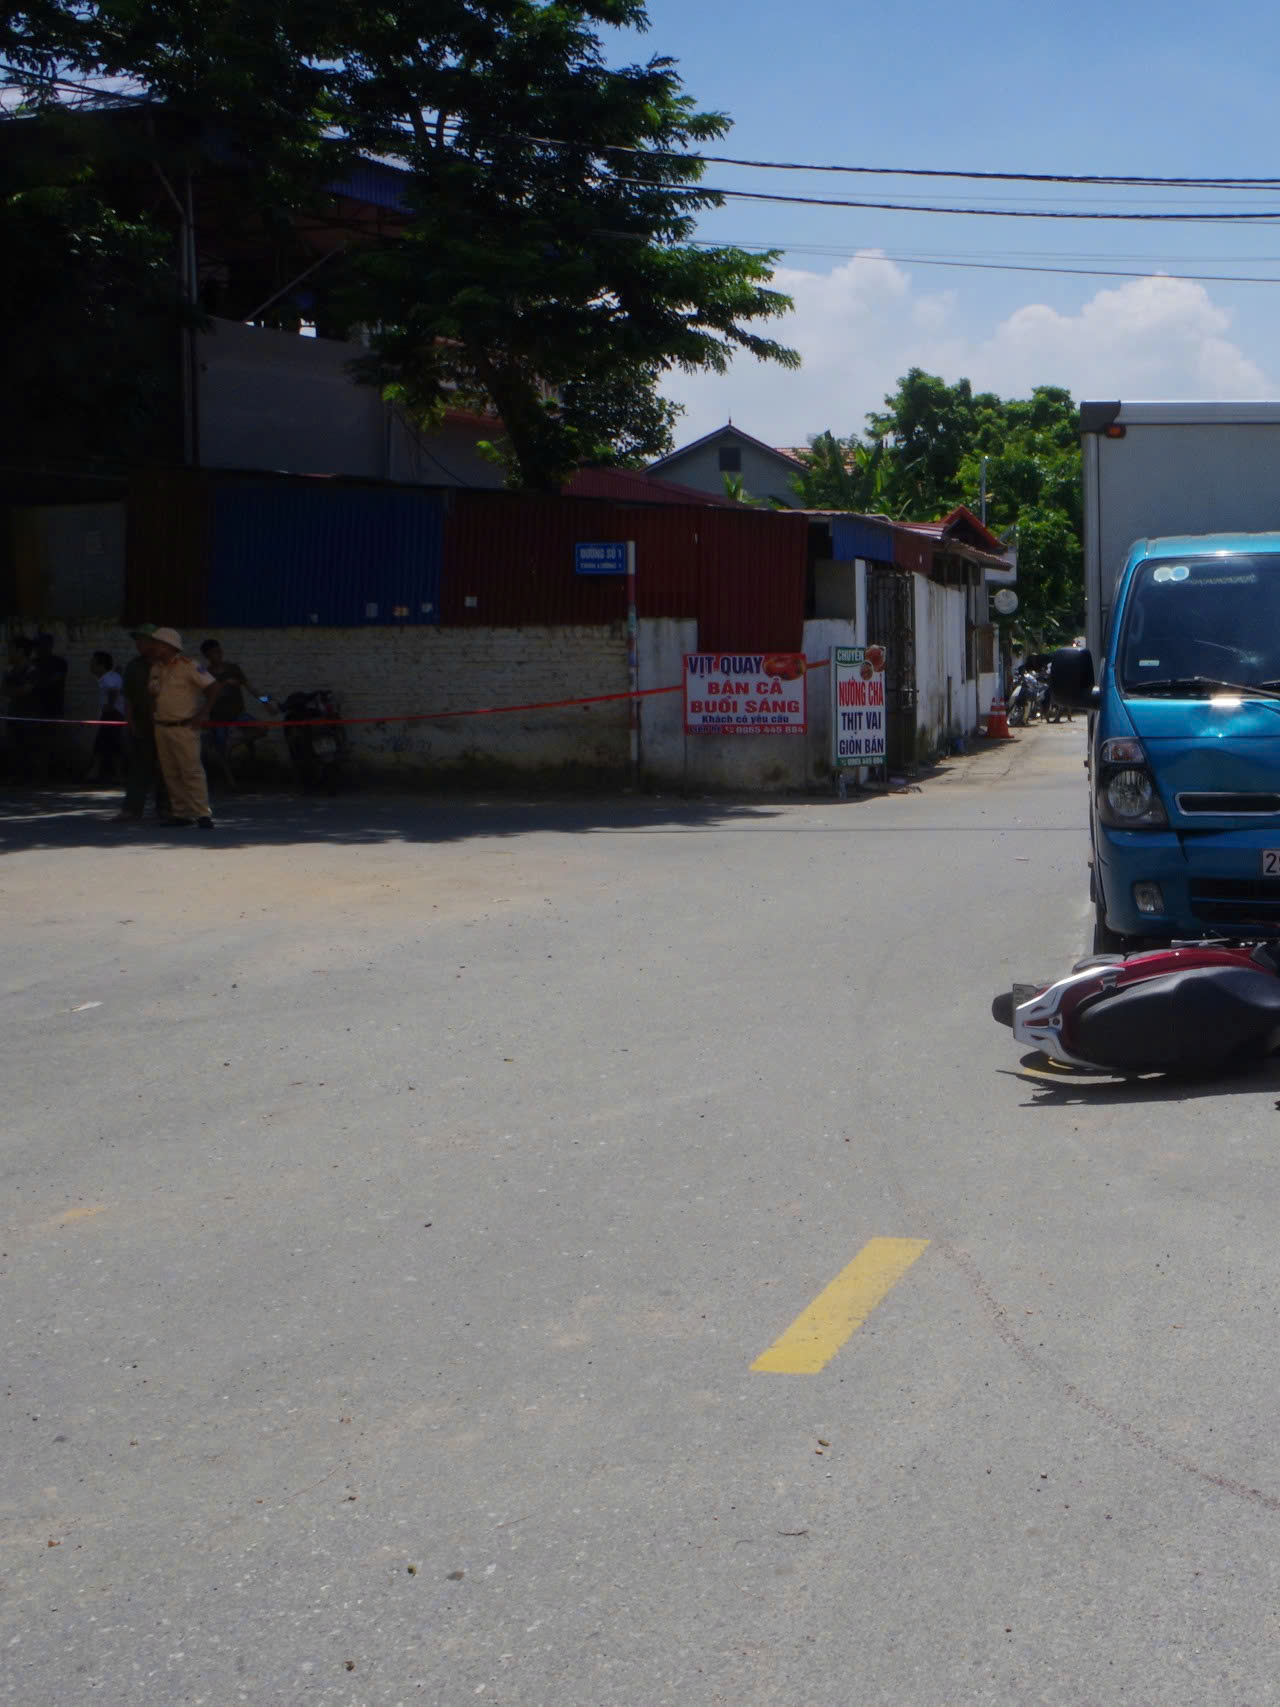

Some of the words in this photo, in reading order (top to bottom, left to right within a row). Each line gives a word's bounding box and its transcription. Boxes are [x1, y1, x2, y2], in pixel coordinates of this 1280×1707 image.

[688, 656, 715, 678] VỊT
[720, 656, 764, 676] QUAY
[744, 698, 801, 714] SÁNG
[841, 711, 864, 734] THỊT
[866, 711, 882, 730] VAI
[864, 735, 885, 754] BÁN
